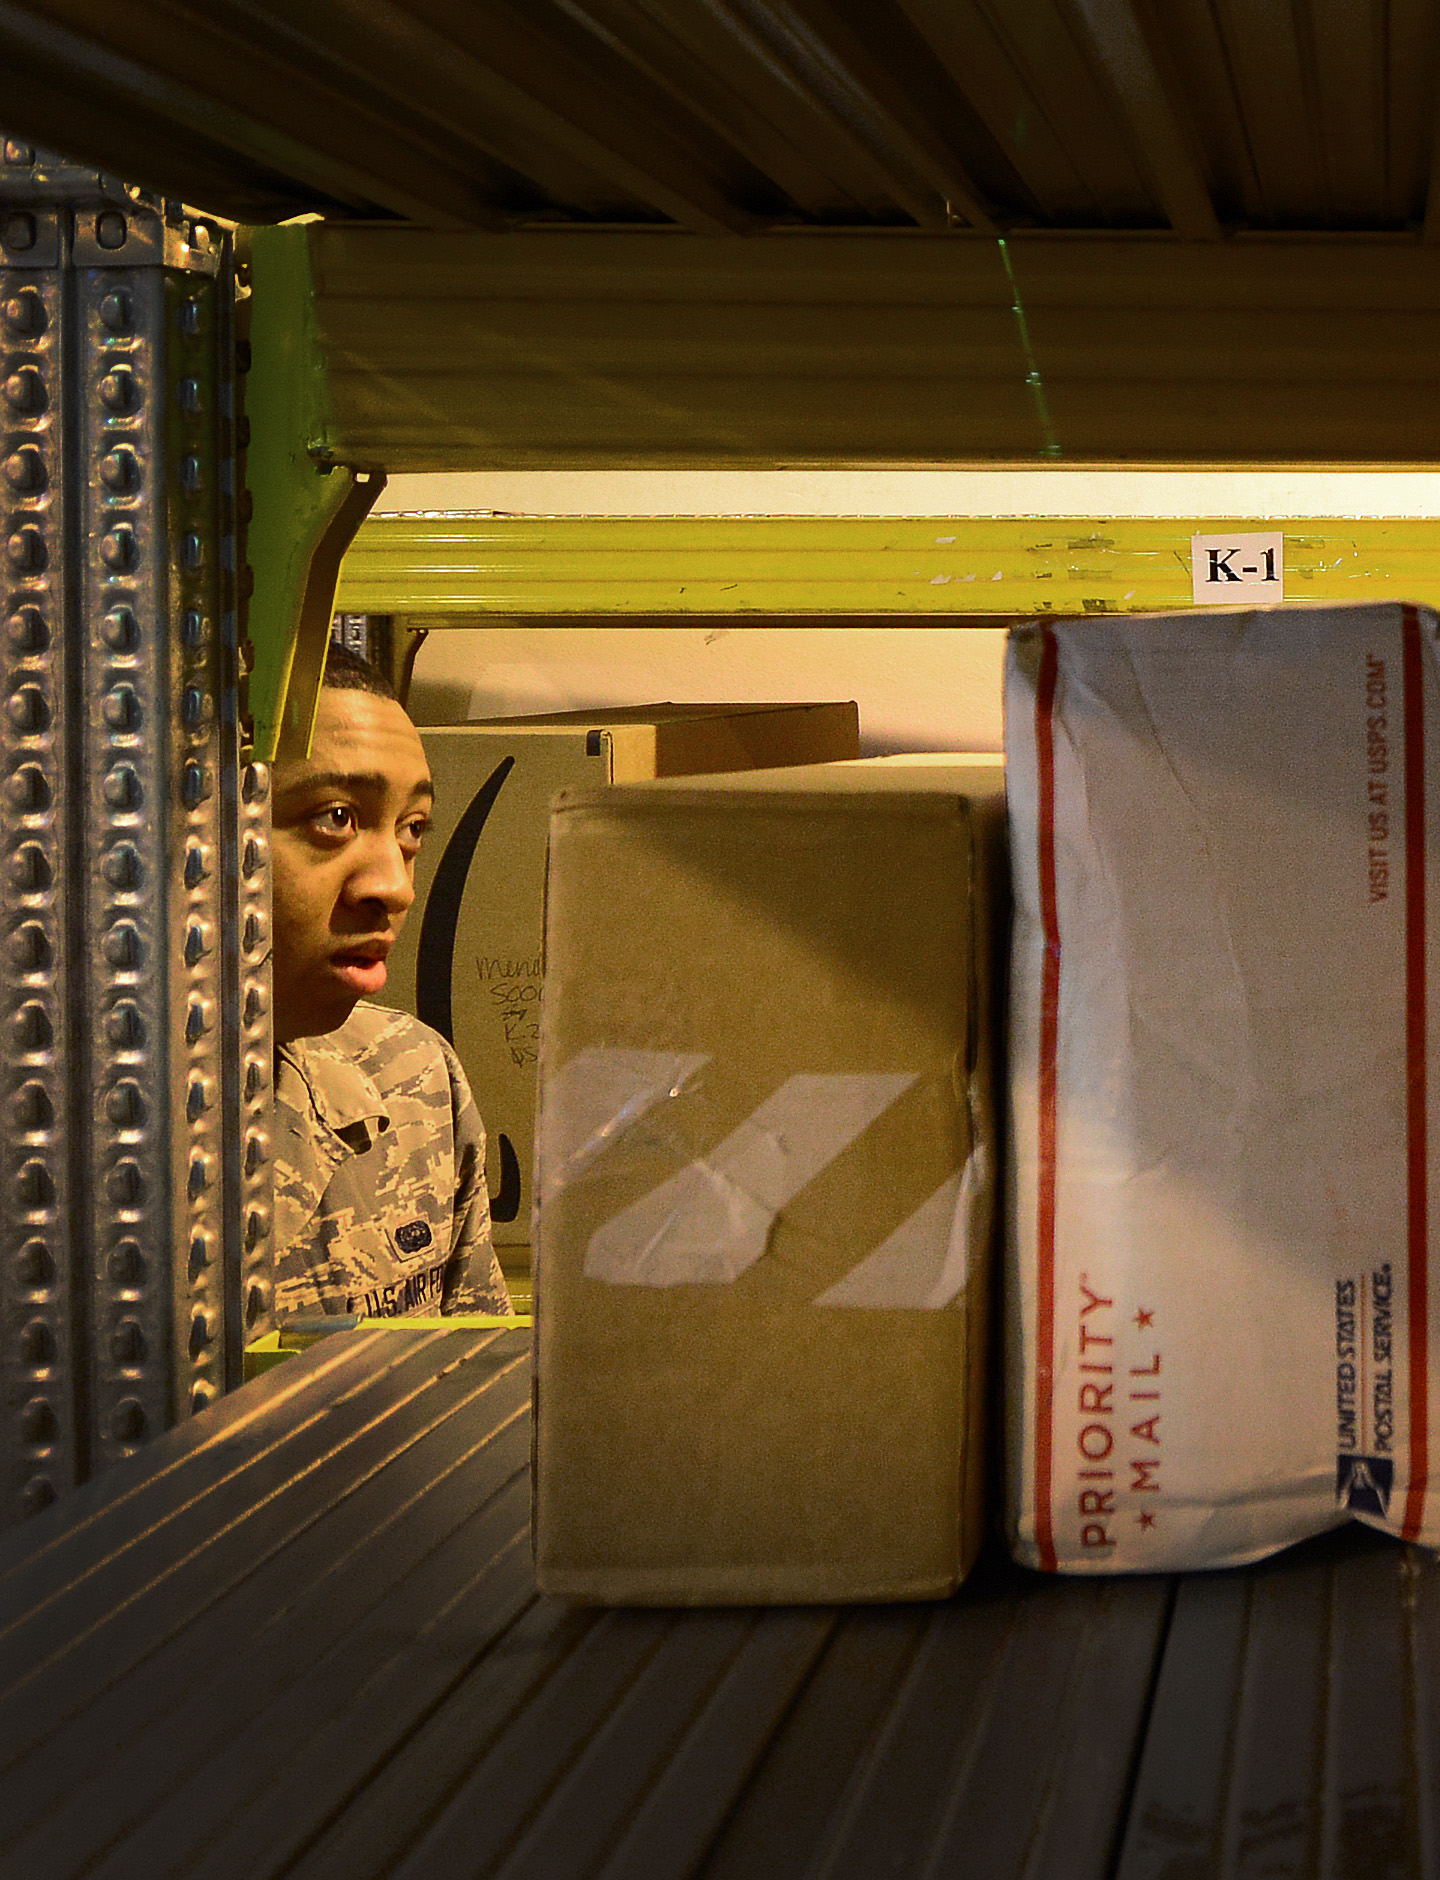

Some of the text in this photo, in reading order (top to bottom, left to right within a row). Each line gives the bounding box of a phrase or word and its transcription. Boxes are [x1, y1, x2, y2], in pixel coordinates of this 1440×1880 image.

[1204, 547, 1280, 583] K-1
[1368, 781, 1389, 806] AT
[1368, 811, 1390, 841] US
[1367, 848, 1389, 903] VISIT
[1336, 1279, 1357, 1450] UNITED STATES
[1129, 1353, 1160, 1493] MAIL
[1373, 1369, 1393, 1453] POSTAL
